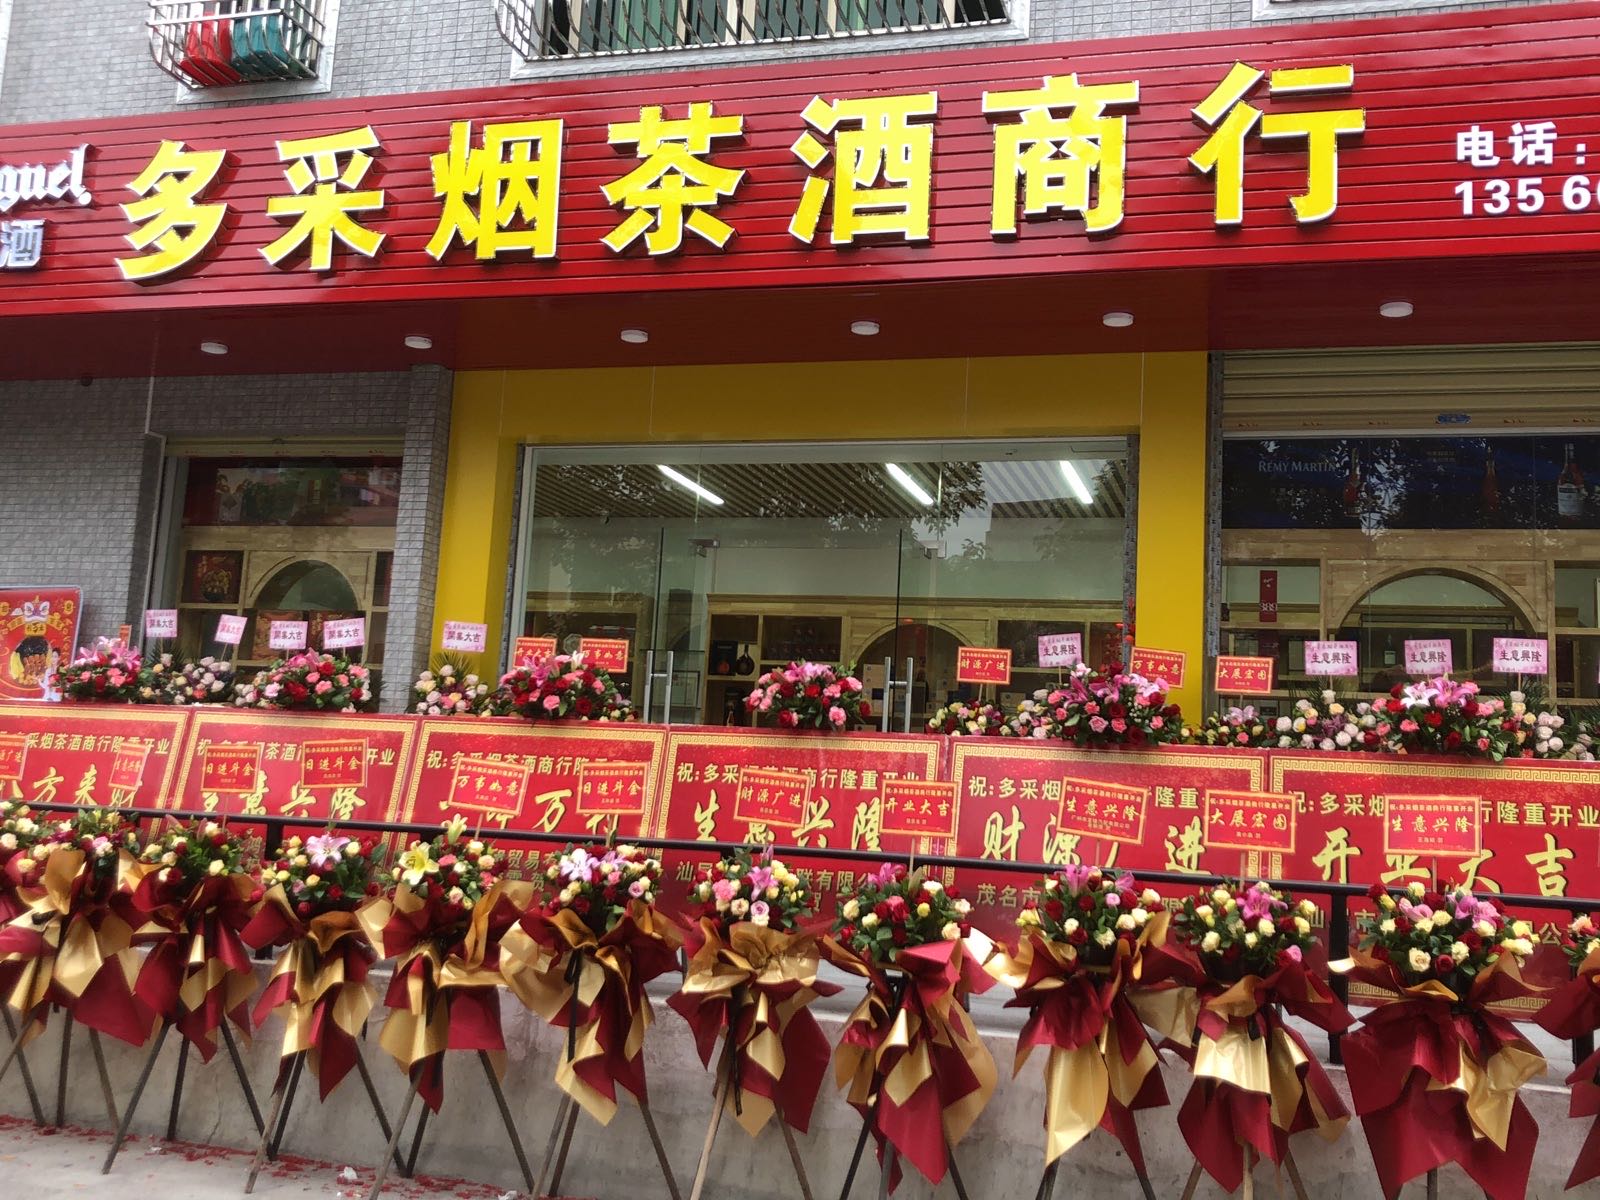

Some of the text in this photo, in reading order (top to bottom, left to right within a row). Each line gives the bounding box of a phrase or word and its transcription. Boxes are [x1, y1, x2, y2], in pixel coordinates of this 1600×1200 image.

[115, 60, 1366, 282] 多采烟茶酒商行
[1455, 175, 1600, 215] 135 6
[961, 658, 1006, 671] 财源广进
[207, 761, 255, 776] 日进斗金
[305, 755, 361, 771] 日进斗金
[457, 775, 519, 796] 万事如意
[583, 779, 642, 796] 日进斗金
[741, 786, 802, 808] 财源广进
[885, 797, 950, 816] 开业大吉
[1067, 796, 1141, 821] 生意兴隆
[1209, 808, 1287, 830] 大展宏图
[1391, 814, 1474, 833] 生意兴隆
